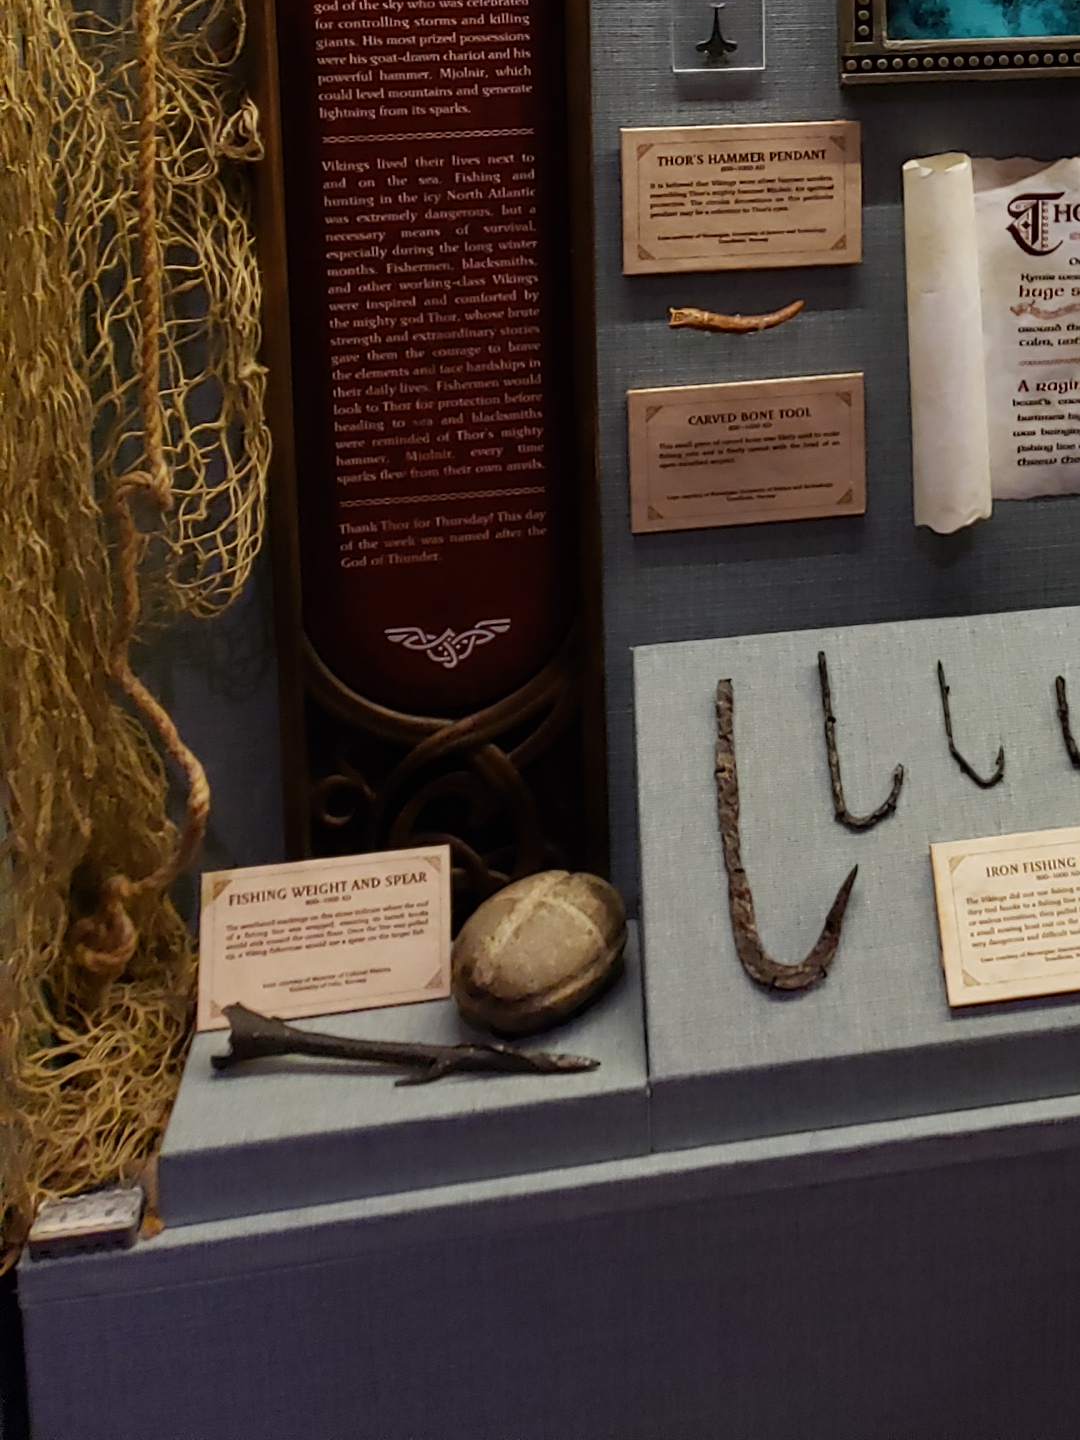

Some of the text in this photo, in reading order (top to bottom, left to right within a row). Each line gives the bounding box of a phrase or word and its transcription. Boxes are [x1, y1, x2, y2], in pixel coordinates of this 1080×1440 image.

[313, 1, 339, 15] god
[341, 1, 356, 11] of
[358, 0, 380, 10] the
[381, 0, 404, 13] sky
[438, 0, 464, 8] was
[314, 14, 530, 32] for controlling storms and killing
[362, 35, 384, 46] His
[385, 34, 417, 45] most
[418, 33, 457, 48] prized
[459, 32, 531, 47] possessions
[316, 57, 347, 65] were
[348, 53, 368, 64] his
[442, 50, 486, 61] chariot
[487, 49, 511, 60] and
[512, 49, 532, 59] his
[317, 71, 373, 86] powerful
[494, 66, 532, 77] which
[317, 84, 533, 100] could level mountains and generate
[318, 106, 376, 121] lightning
[378, 105, 409, 116] from
[411, 105, 427, 115] its
[321, 153, 535, 174] Vikings lived their lives next to
[657, 149, 827, 167] THOR'S HAMMER PENDANT
[322, 178, 347, 188] and
[357, 179, 376, 187] on
[386, 175, 408, 186] the
[454, 172, 502, 187] Fishing
[511, 171, 536, 181] and
[323, 188, 535, 209] hunting in the icy North Atlantic
[1018, 284, 1064, 300] huge
[1017, 379, 1029, 392] A
[688, 407, 812, 426] CARVED BONE TOOL
[986, 864, 1019, 878] IRON
[1023, 857, 1076, 874] FISHING
[228, 888, 287, 907] FISHING
[292, 881, 348, 898] WEIGHT
[351, 877, 381, 891] AND
[385, 872, 428, 887] SPEAR
